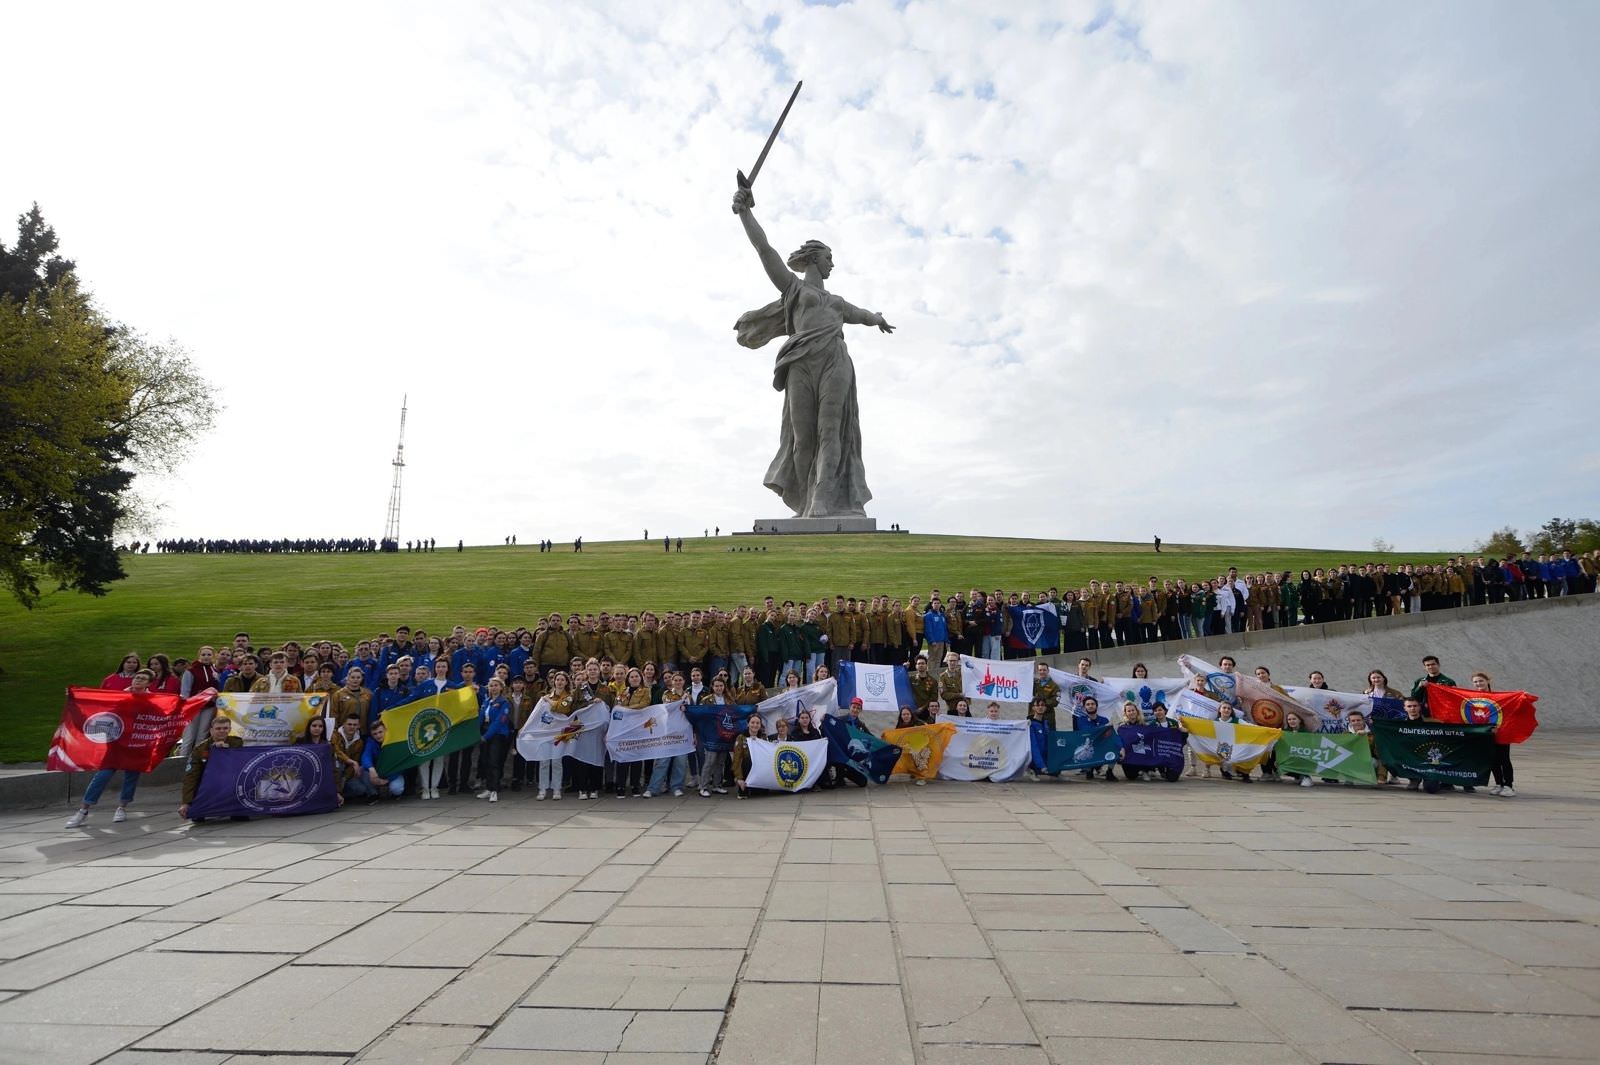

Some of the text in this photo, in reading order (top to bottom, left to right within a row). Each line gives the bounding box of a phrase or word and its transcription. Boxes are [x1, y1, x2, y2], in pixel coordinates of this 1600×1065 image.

[996, 676, 1018, 687] Мос
[996, 686, 1019, 699] РСО
[1398, 727, 1443, 736] АДЫГЕЙСКИЙ
[1290, 746, 1311, 756] РСО
[1312, 749, 1329, 761] 21
